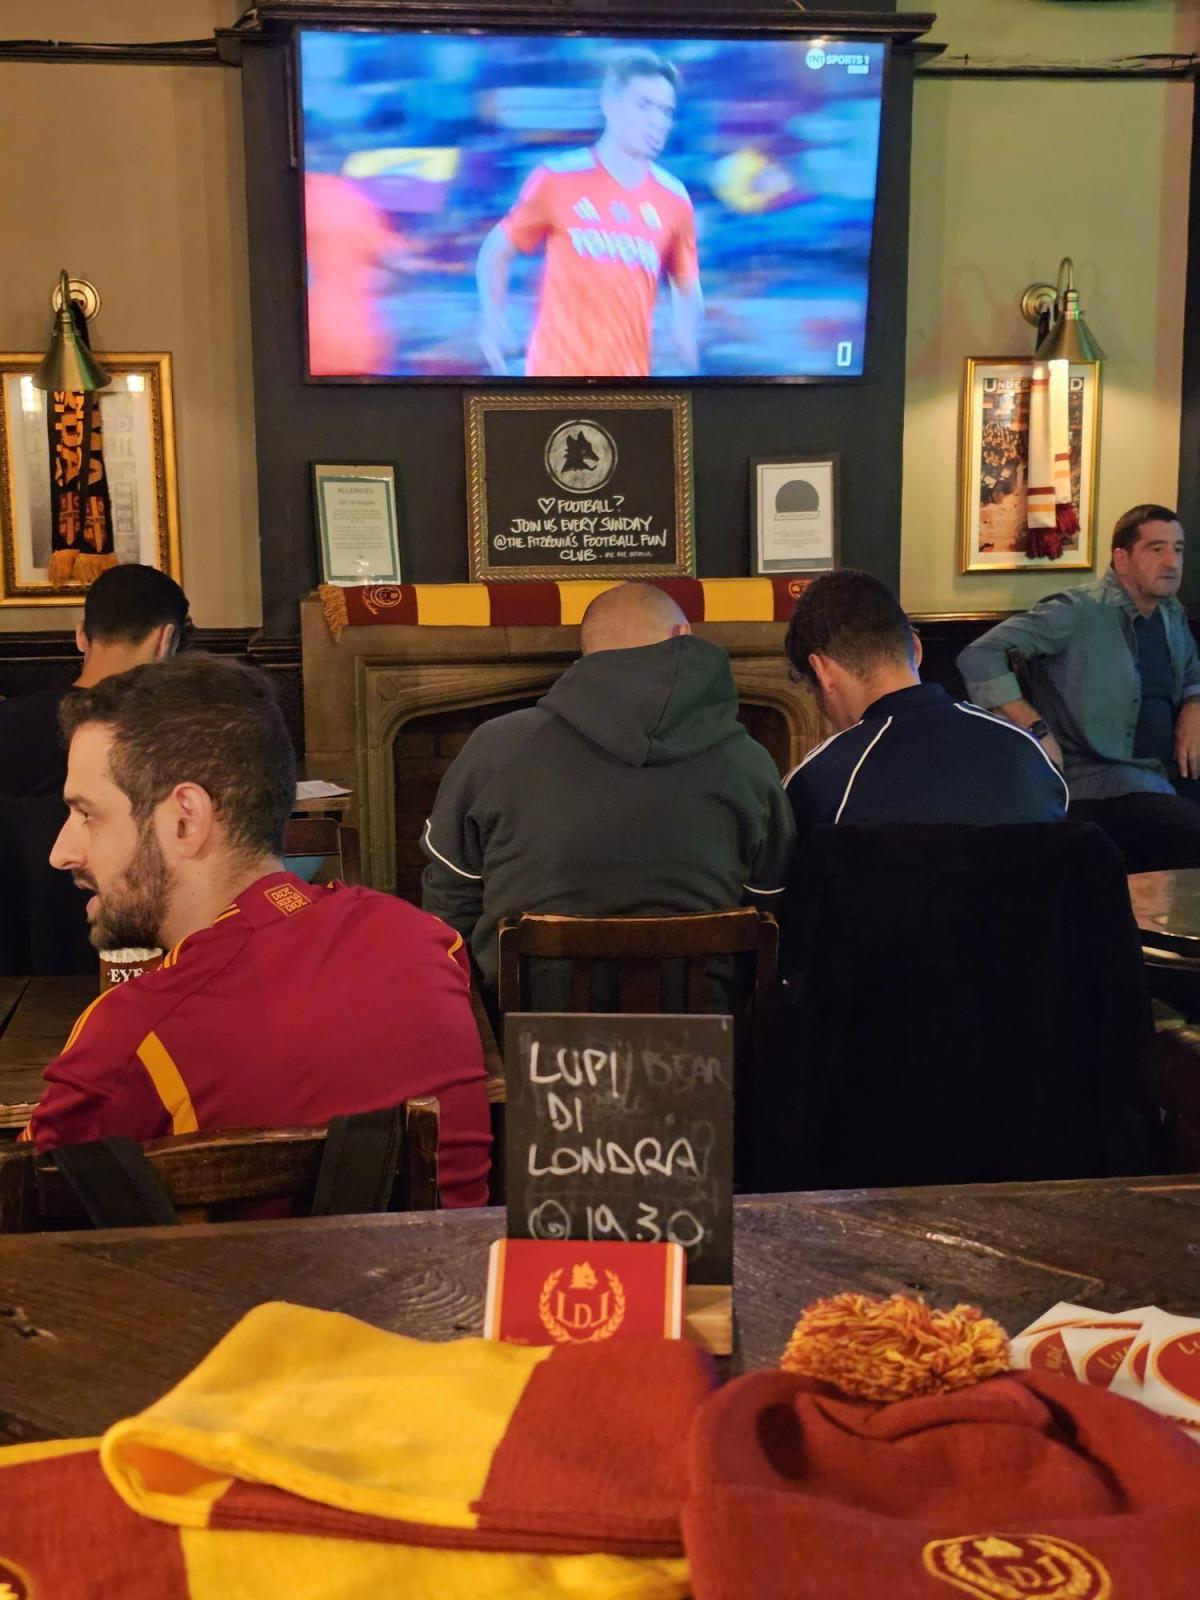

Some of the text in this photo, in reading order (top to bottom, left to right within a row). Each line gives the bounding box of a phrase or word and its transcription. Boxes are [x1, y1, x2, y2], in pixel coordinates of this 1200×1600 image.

[826, 54, 863, 65] SPORTS
[863, 54, 870, 65] 1
[557, 495, 625, 514] FOOTBALL?
[511, 516, 653, 533] JOIN US EVERY SUNDAY
[583, 535, 638, 548] FOOTBALL
[640, 529, 668, 547] FUN
[530, 1041, 619, 1098] LUPI
[548, 1092, 583, 1134] DI
[528, 1138, 703, 1177] LONDRA
[586, 1202, 704, 1247] 19.30
